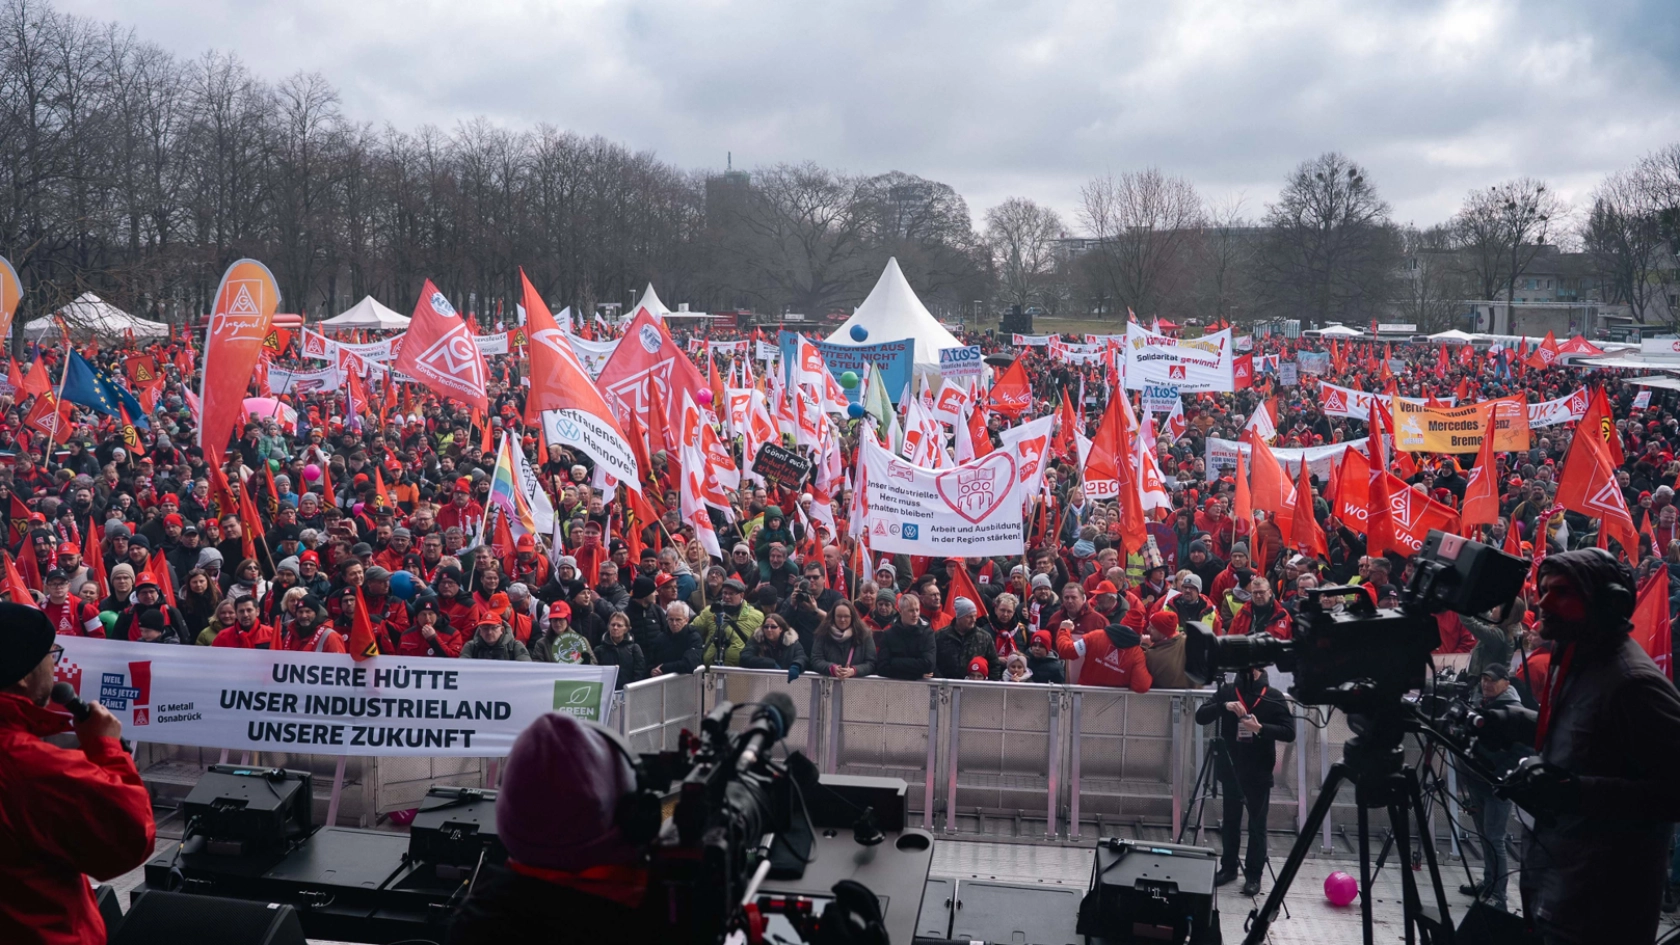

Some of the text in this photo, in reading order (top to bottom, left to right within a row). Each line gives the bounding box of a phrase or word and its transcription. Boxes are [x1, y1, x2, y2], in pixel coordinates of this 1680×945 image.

[213, 313, 267, 336] Jugend!
[880, 343, 906, 351] AUS
[940, 346, 980, 362] Atos
[1180, 358, 1221, 370] gewinnt!
[406, 364, 428, 380] Körber
[437, 376, 481, 399] Technologies
[1143, 385, 1178, 398] Atos
[1429, 419, 1479, 431] Mercedes
[1495, 419, 1510, 429] enz
[1451, 435, 1482, 447] Breme
[583, 431, 634, 477] Hannover
[708, 453, 730, 465] IGBCE
[764, 445, 789, 462] Gönnt
[888, 484, 939, 500] industrielles
[880, 492, 921, 507] Herz muss
[868, 503, 934, 519] erhalten bleiben!
[930, 525, 956, 533] Arbeit
[975, 522, 1021, 532] Ausbildung
[957, 535, 985, 544] Region
[987, 532, 1021, 542] stärken!
[104, 675, 122, 684] WEIL
[272, 663, 459, 690] UNSERE HÜTTE
[102, 687, 139, 699] DAS JETZT
[101, 699, 125, 709] ZÄHLT.
[157, 702, 194, 712] IG Metall
[220, 689, 512, 720] UNSER INDUSTRIELAND
[558, 706, 595, 715] GREEN
[157, 712, 202, 723] Osnabrück
[247, 721, 476, 748] UNSERE ZUKUNFT
